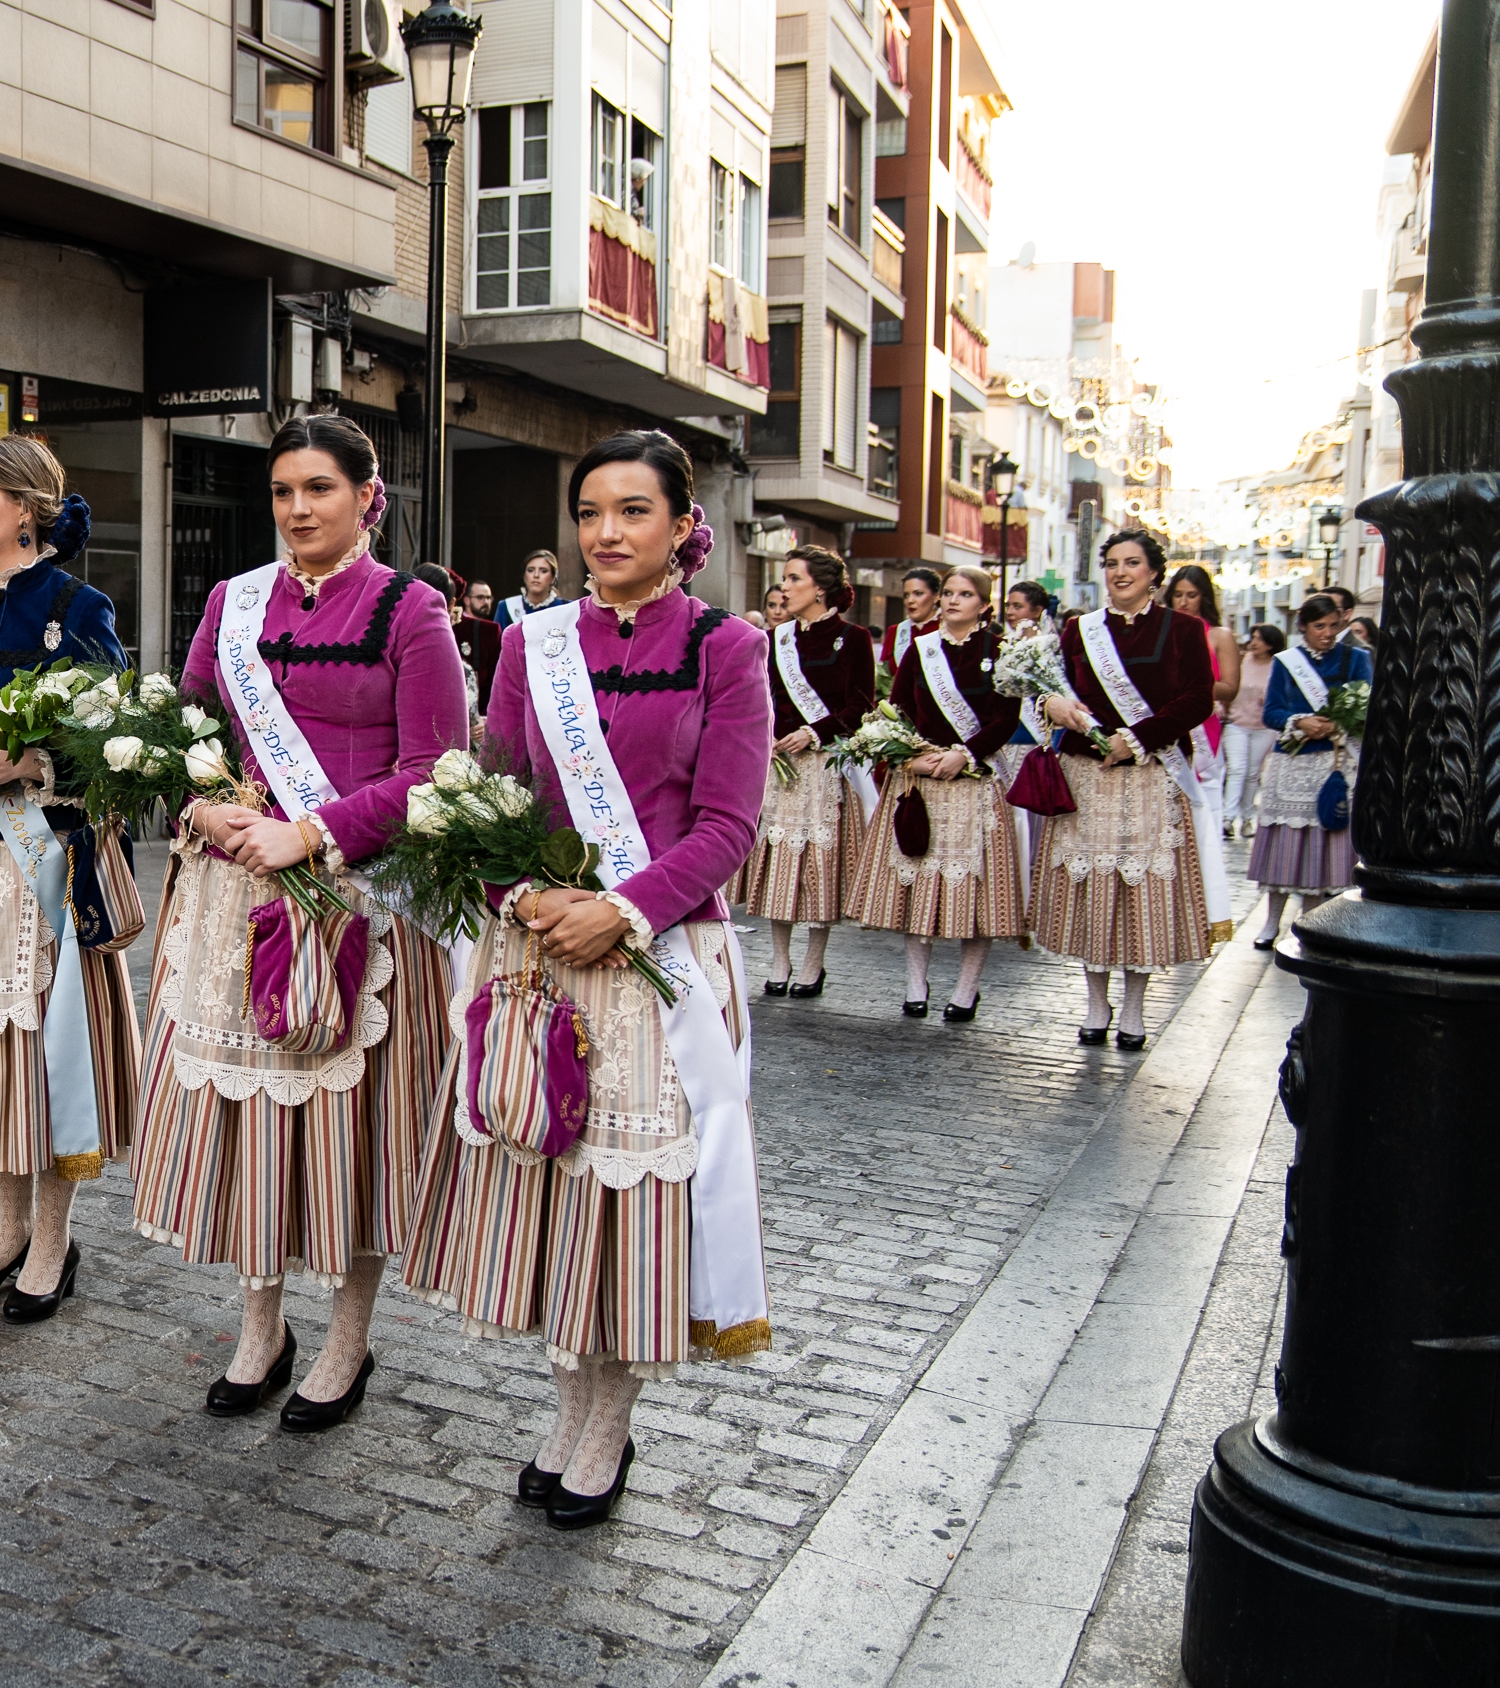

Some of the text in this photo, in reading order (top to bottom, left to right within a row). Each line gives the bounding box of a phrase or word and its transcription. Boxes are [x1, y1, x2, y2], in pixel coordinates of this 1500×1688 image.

[158, 386, 261, 405] CALZEDONIA
[227, 415, 236, 435] 7
[229, 643, 260, 711] DAMA
[263, 731, 293, 765] DE
[551, 678, 587, 755] DAMA
[583, 780, 612, 819] DE
